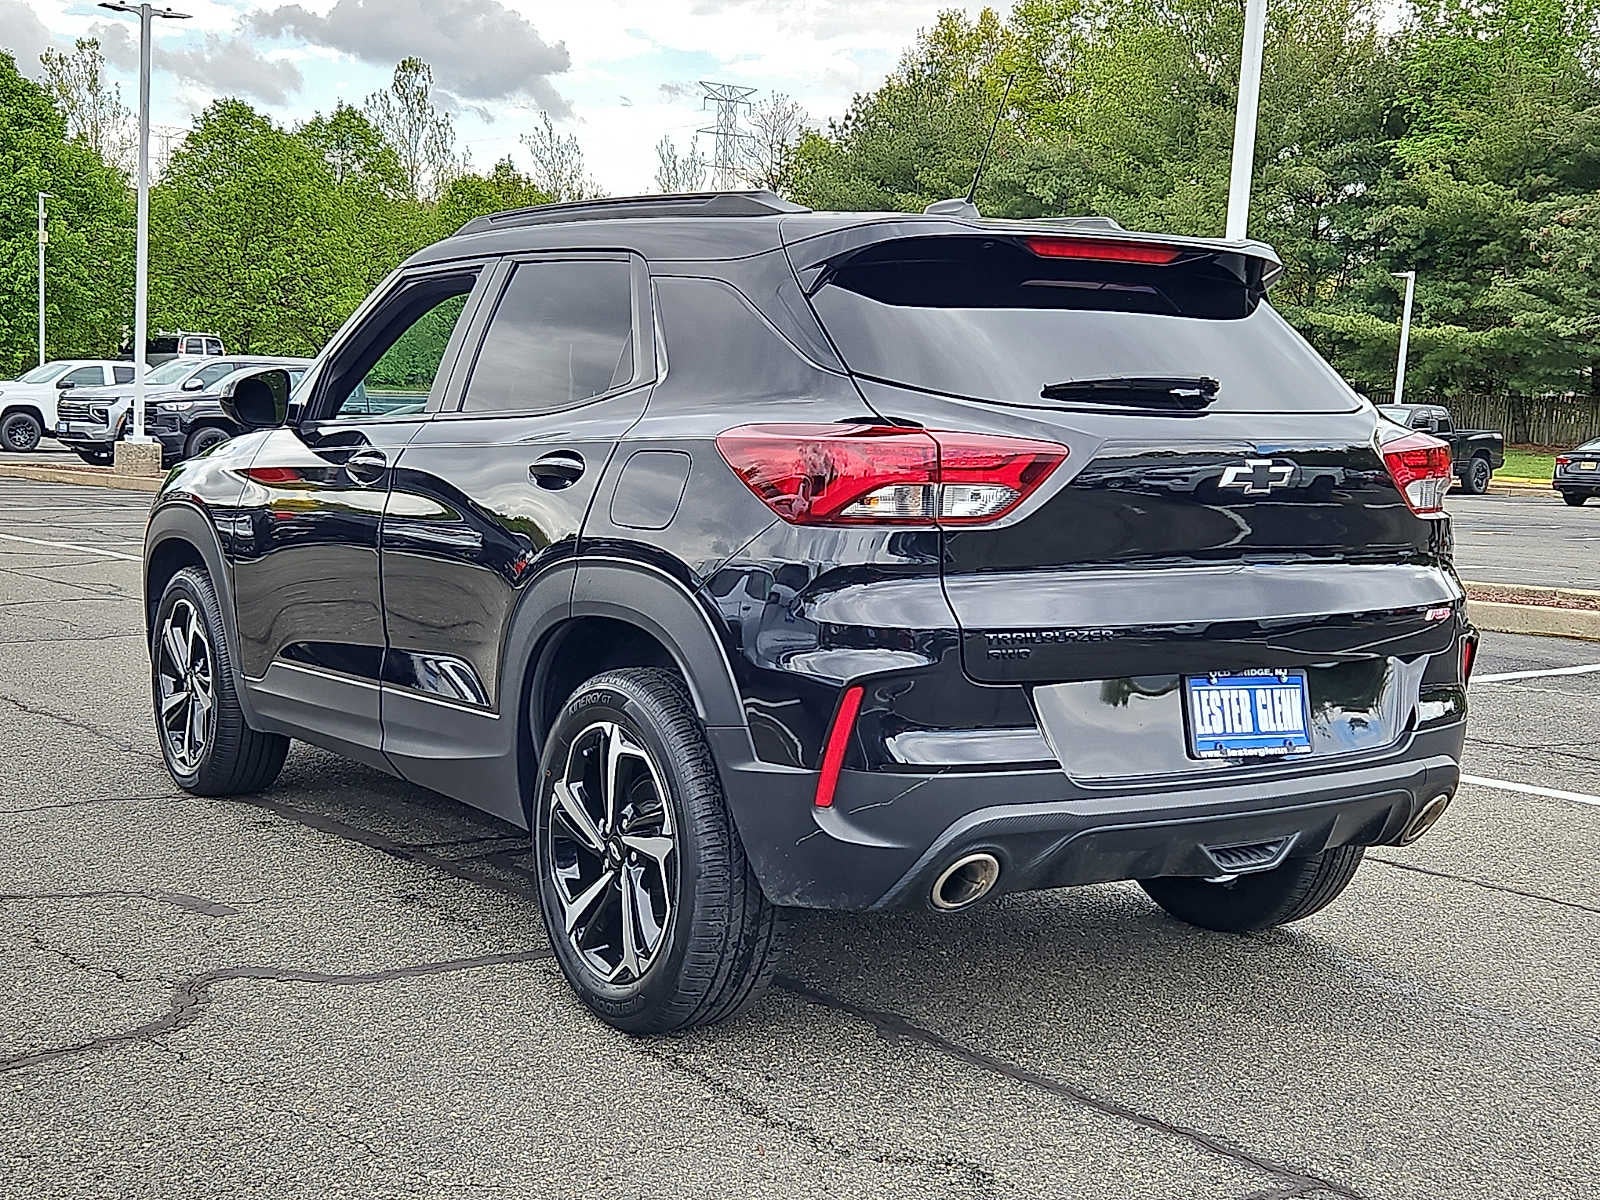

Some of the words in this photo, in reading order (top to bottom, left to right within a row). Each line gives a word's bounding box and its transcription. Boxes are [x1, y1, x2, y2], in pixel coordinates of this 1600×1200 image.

[984, 630, 1114, 645] TRAILBLAZER
[568, 692, 602, 716] KINERGY
[601, 694, 612, 705] GT
[1192, 689, 1254, 735] LESTER
[1255, 687, 1304, 732] GLENN
